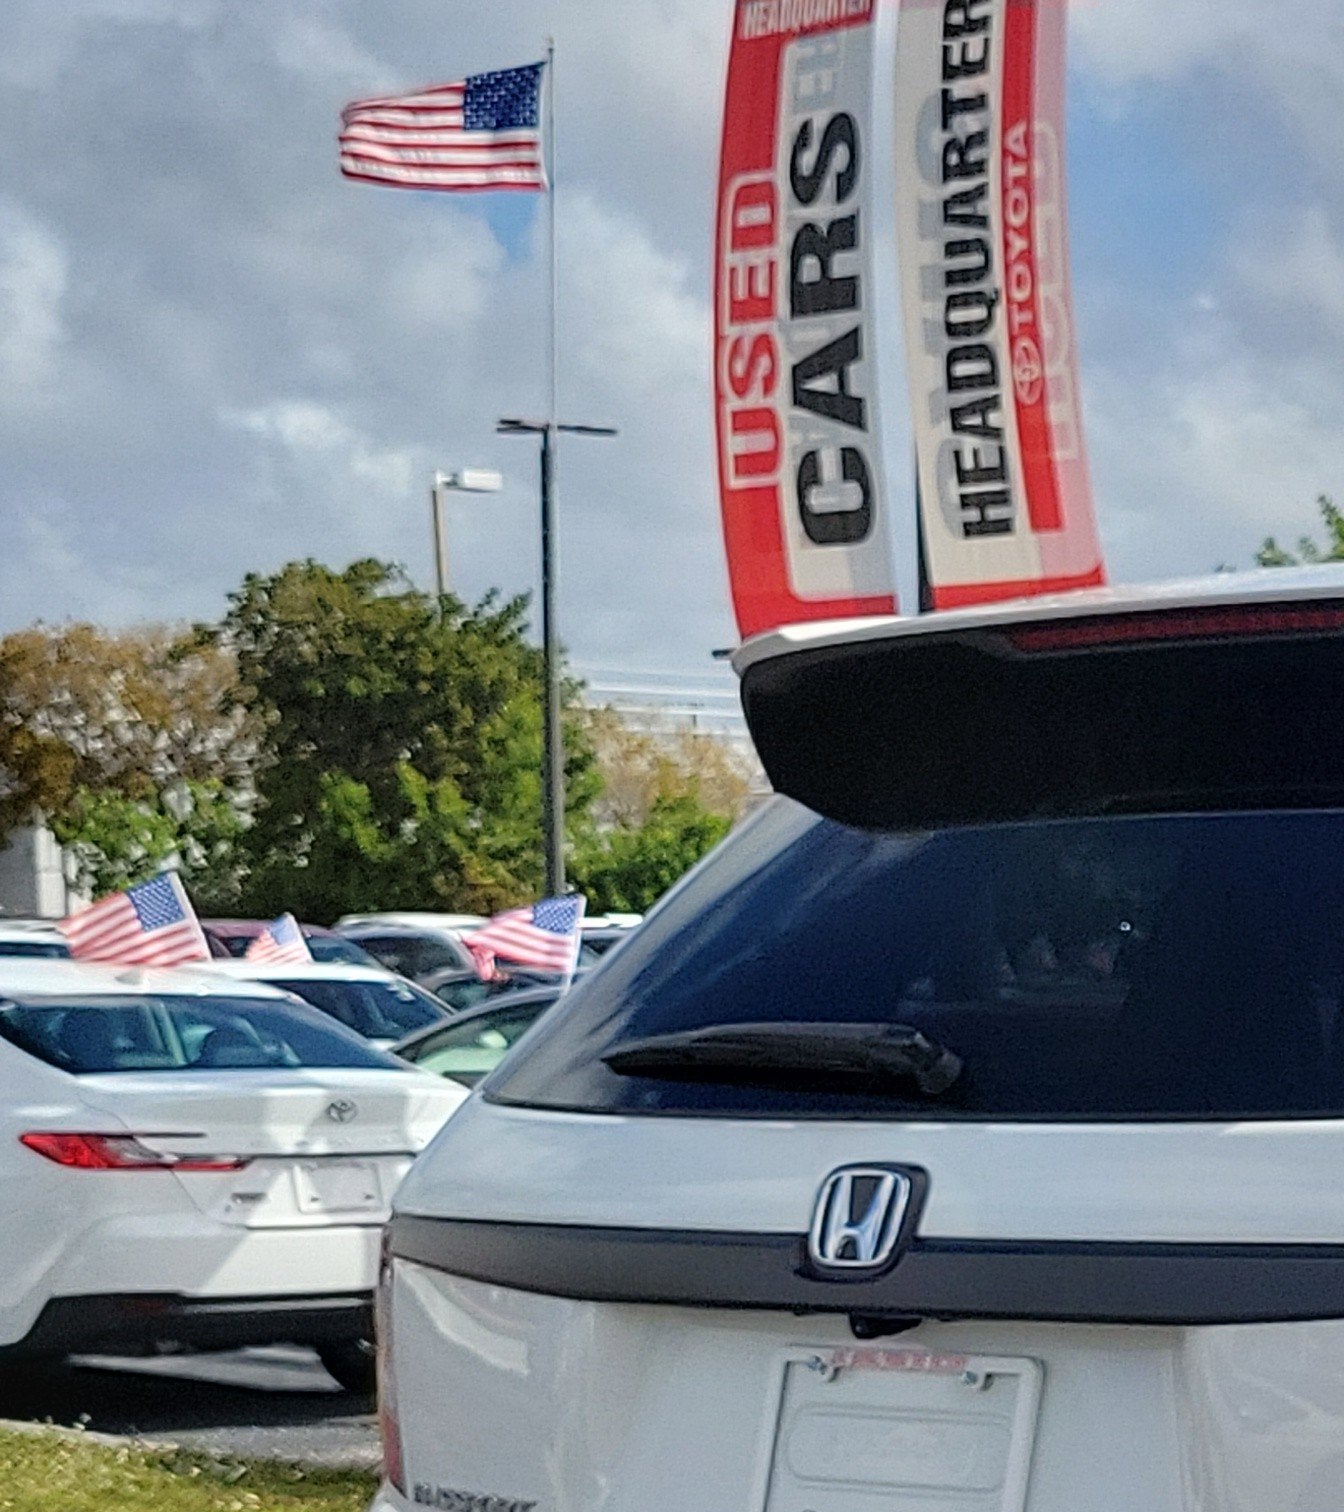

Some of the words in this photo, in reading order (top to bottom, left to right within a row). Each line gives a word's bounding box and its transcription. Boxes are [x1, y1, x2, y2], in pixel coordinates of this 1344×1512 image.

[727, 172, 782, 488] USED
[789, 113, 873, 544] CARS
[941, 0, 1014, 540] HEADQUARTER
[1004, 119, 1035, 328] TOYOTA
